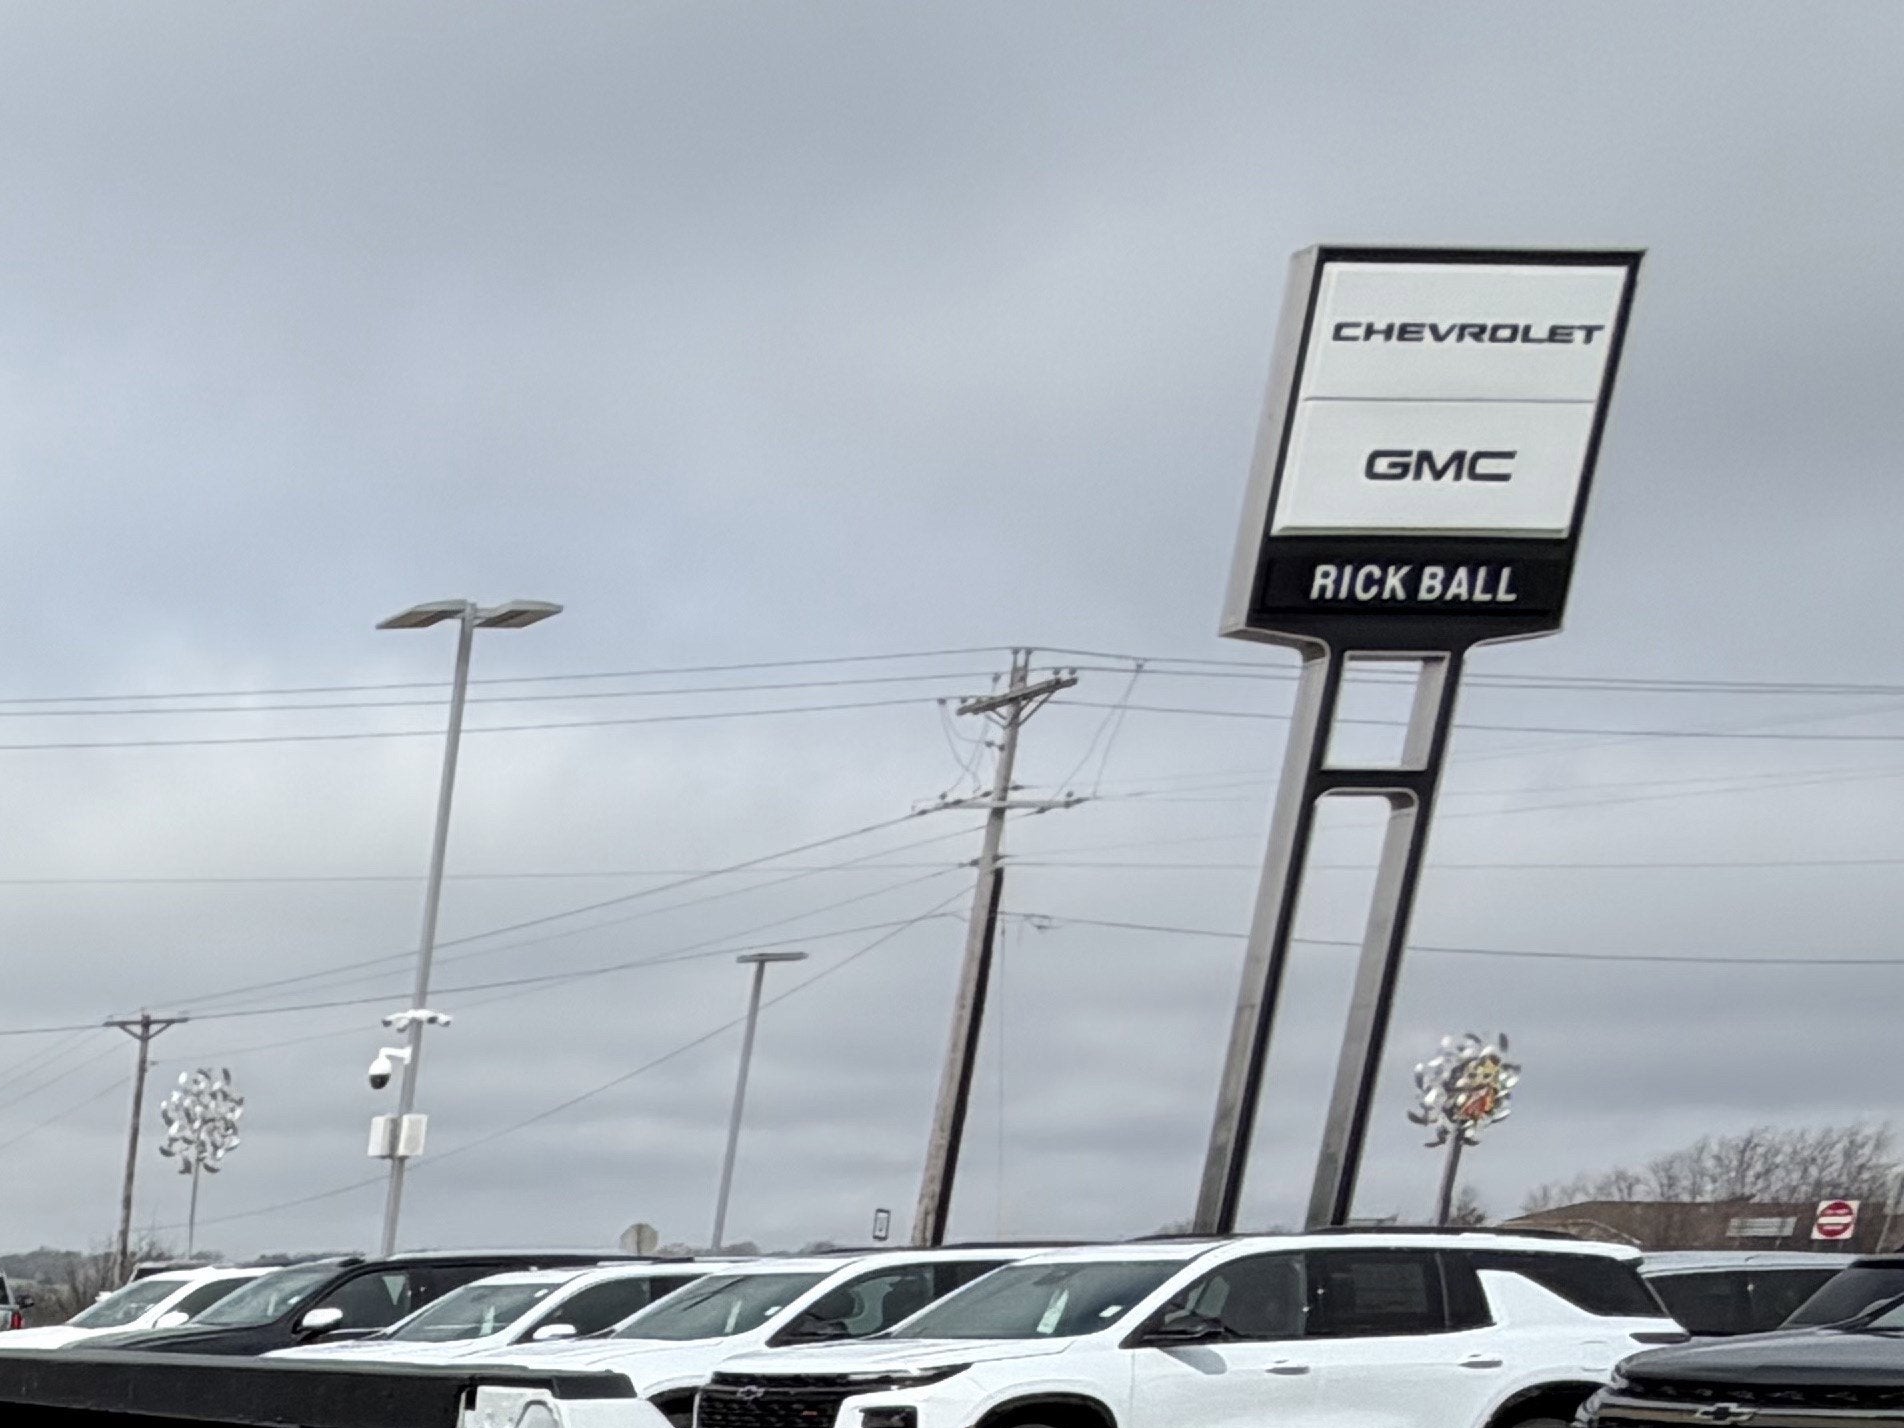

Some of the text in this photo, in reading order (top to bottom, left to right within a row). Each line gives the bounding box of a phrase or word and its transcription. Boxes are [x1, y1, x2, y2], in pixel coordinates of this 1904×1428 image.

[1331, 321, 1605, 345] CHEVROLET
[1364, 449, 1518, 482] GMC
[1309, 564, 1518, 602] RICK BALL
